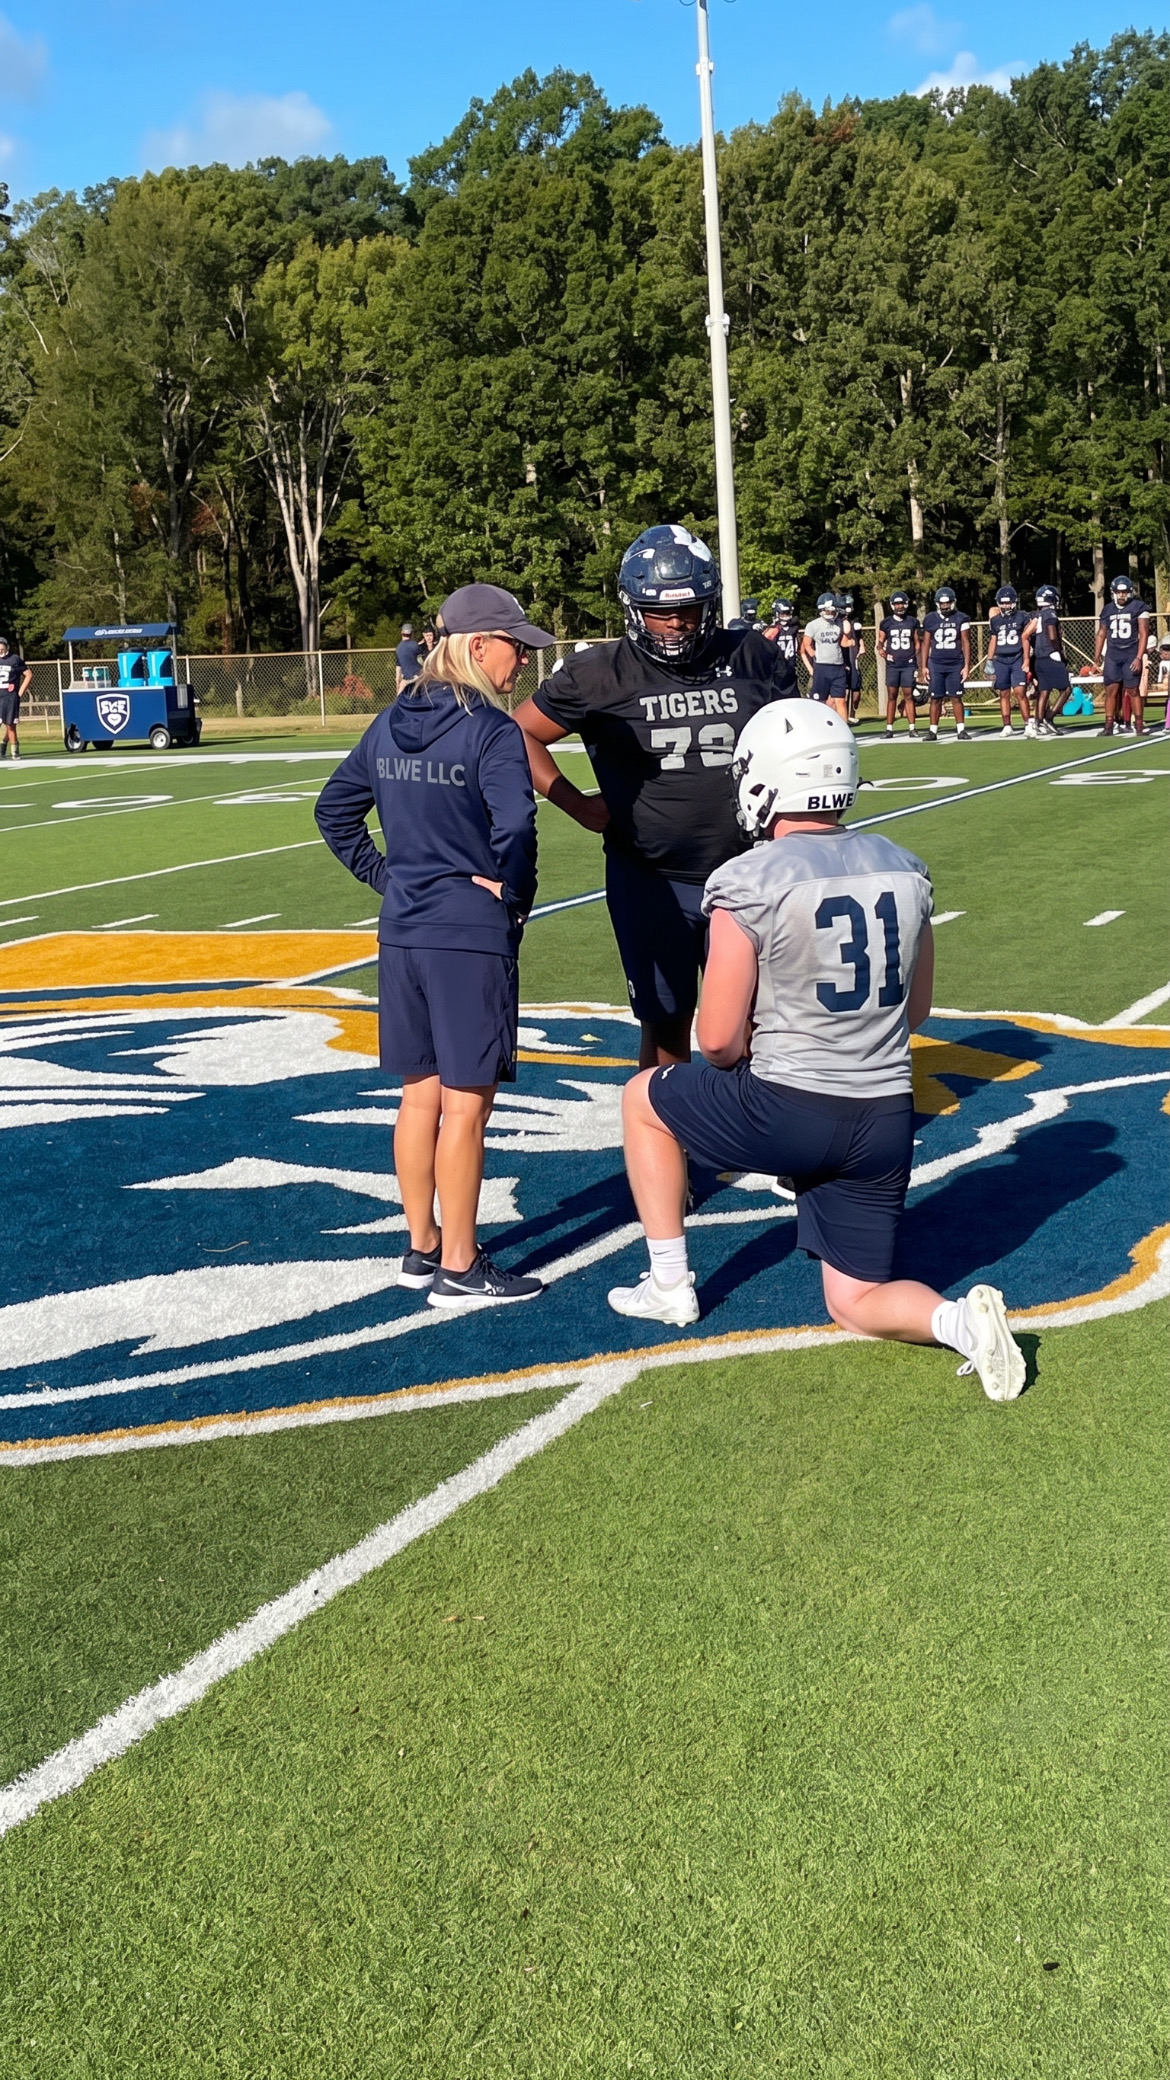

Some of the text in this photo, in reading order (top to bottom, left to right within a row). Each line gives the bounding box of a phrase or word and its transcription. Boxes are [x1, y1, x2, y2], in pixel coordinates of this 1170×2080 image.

[640, 687, 738, 721] TIGERS
[377, 757, 466, 787] BLWE LLC
[807, 792, 854, 810] BLWE
[815, 891, 904, 1012] 31
